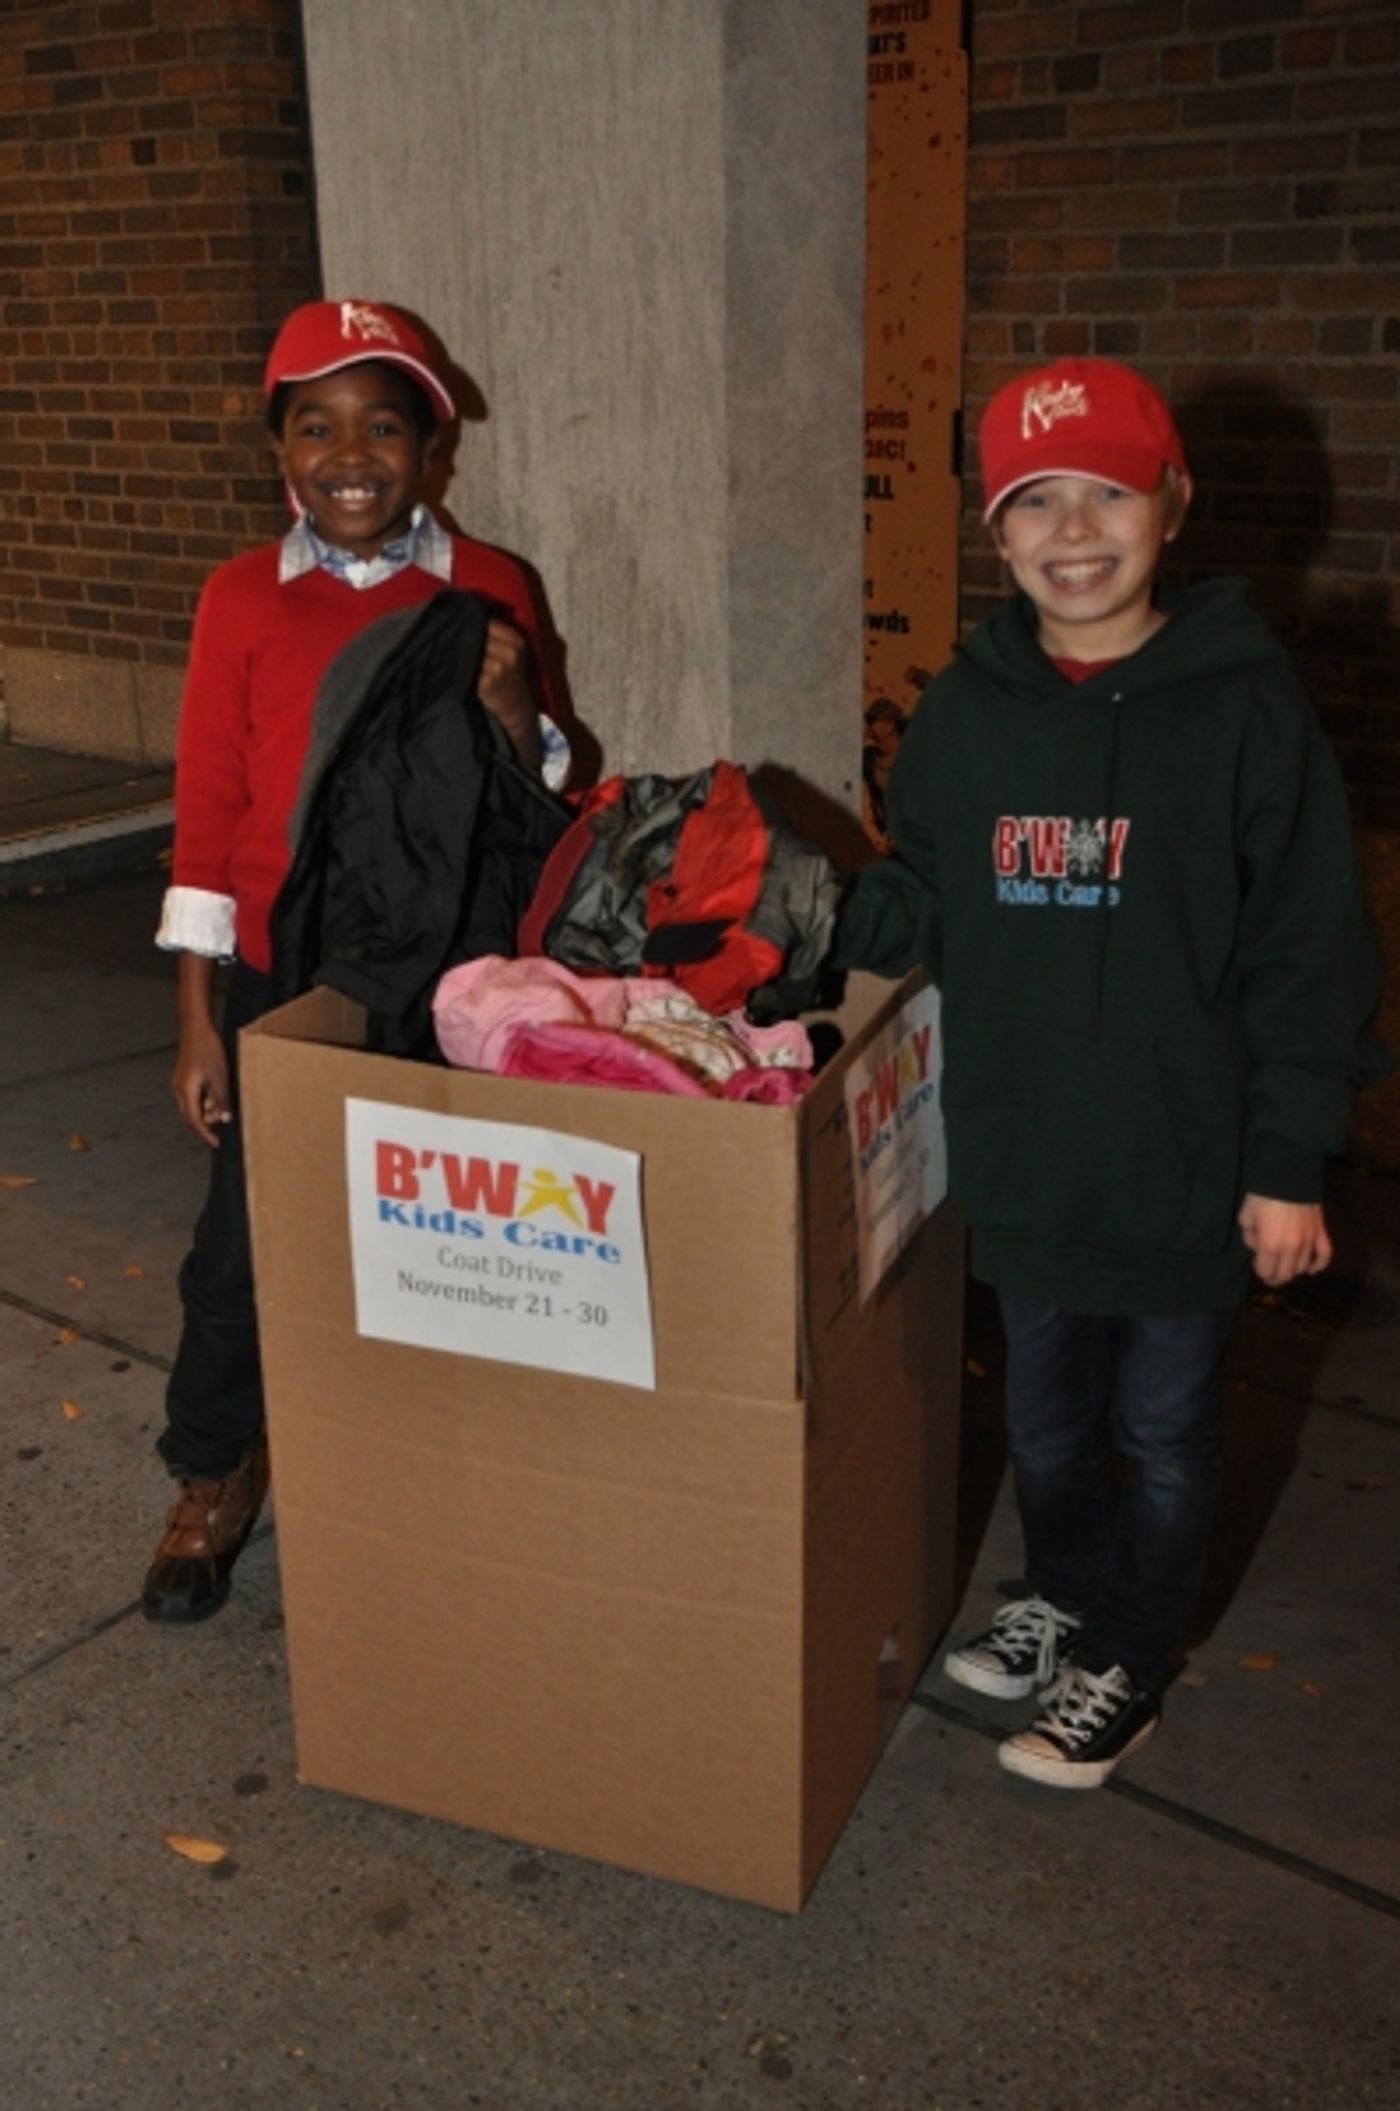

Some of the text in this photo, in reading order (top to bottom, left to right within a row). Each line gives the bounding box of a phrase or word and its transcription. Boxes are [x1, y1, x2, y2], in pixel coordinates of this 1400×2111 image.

[863, 610, 909, 634] wds
[378, 1199, 621, 1265] Kids Care
[437, 1245, 564, 1285] Coat Drive
[397, 1270, 519, 1311] November
[524, 1291, 554, 1317] 21
[577, 1301, 609, 1327] 30
